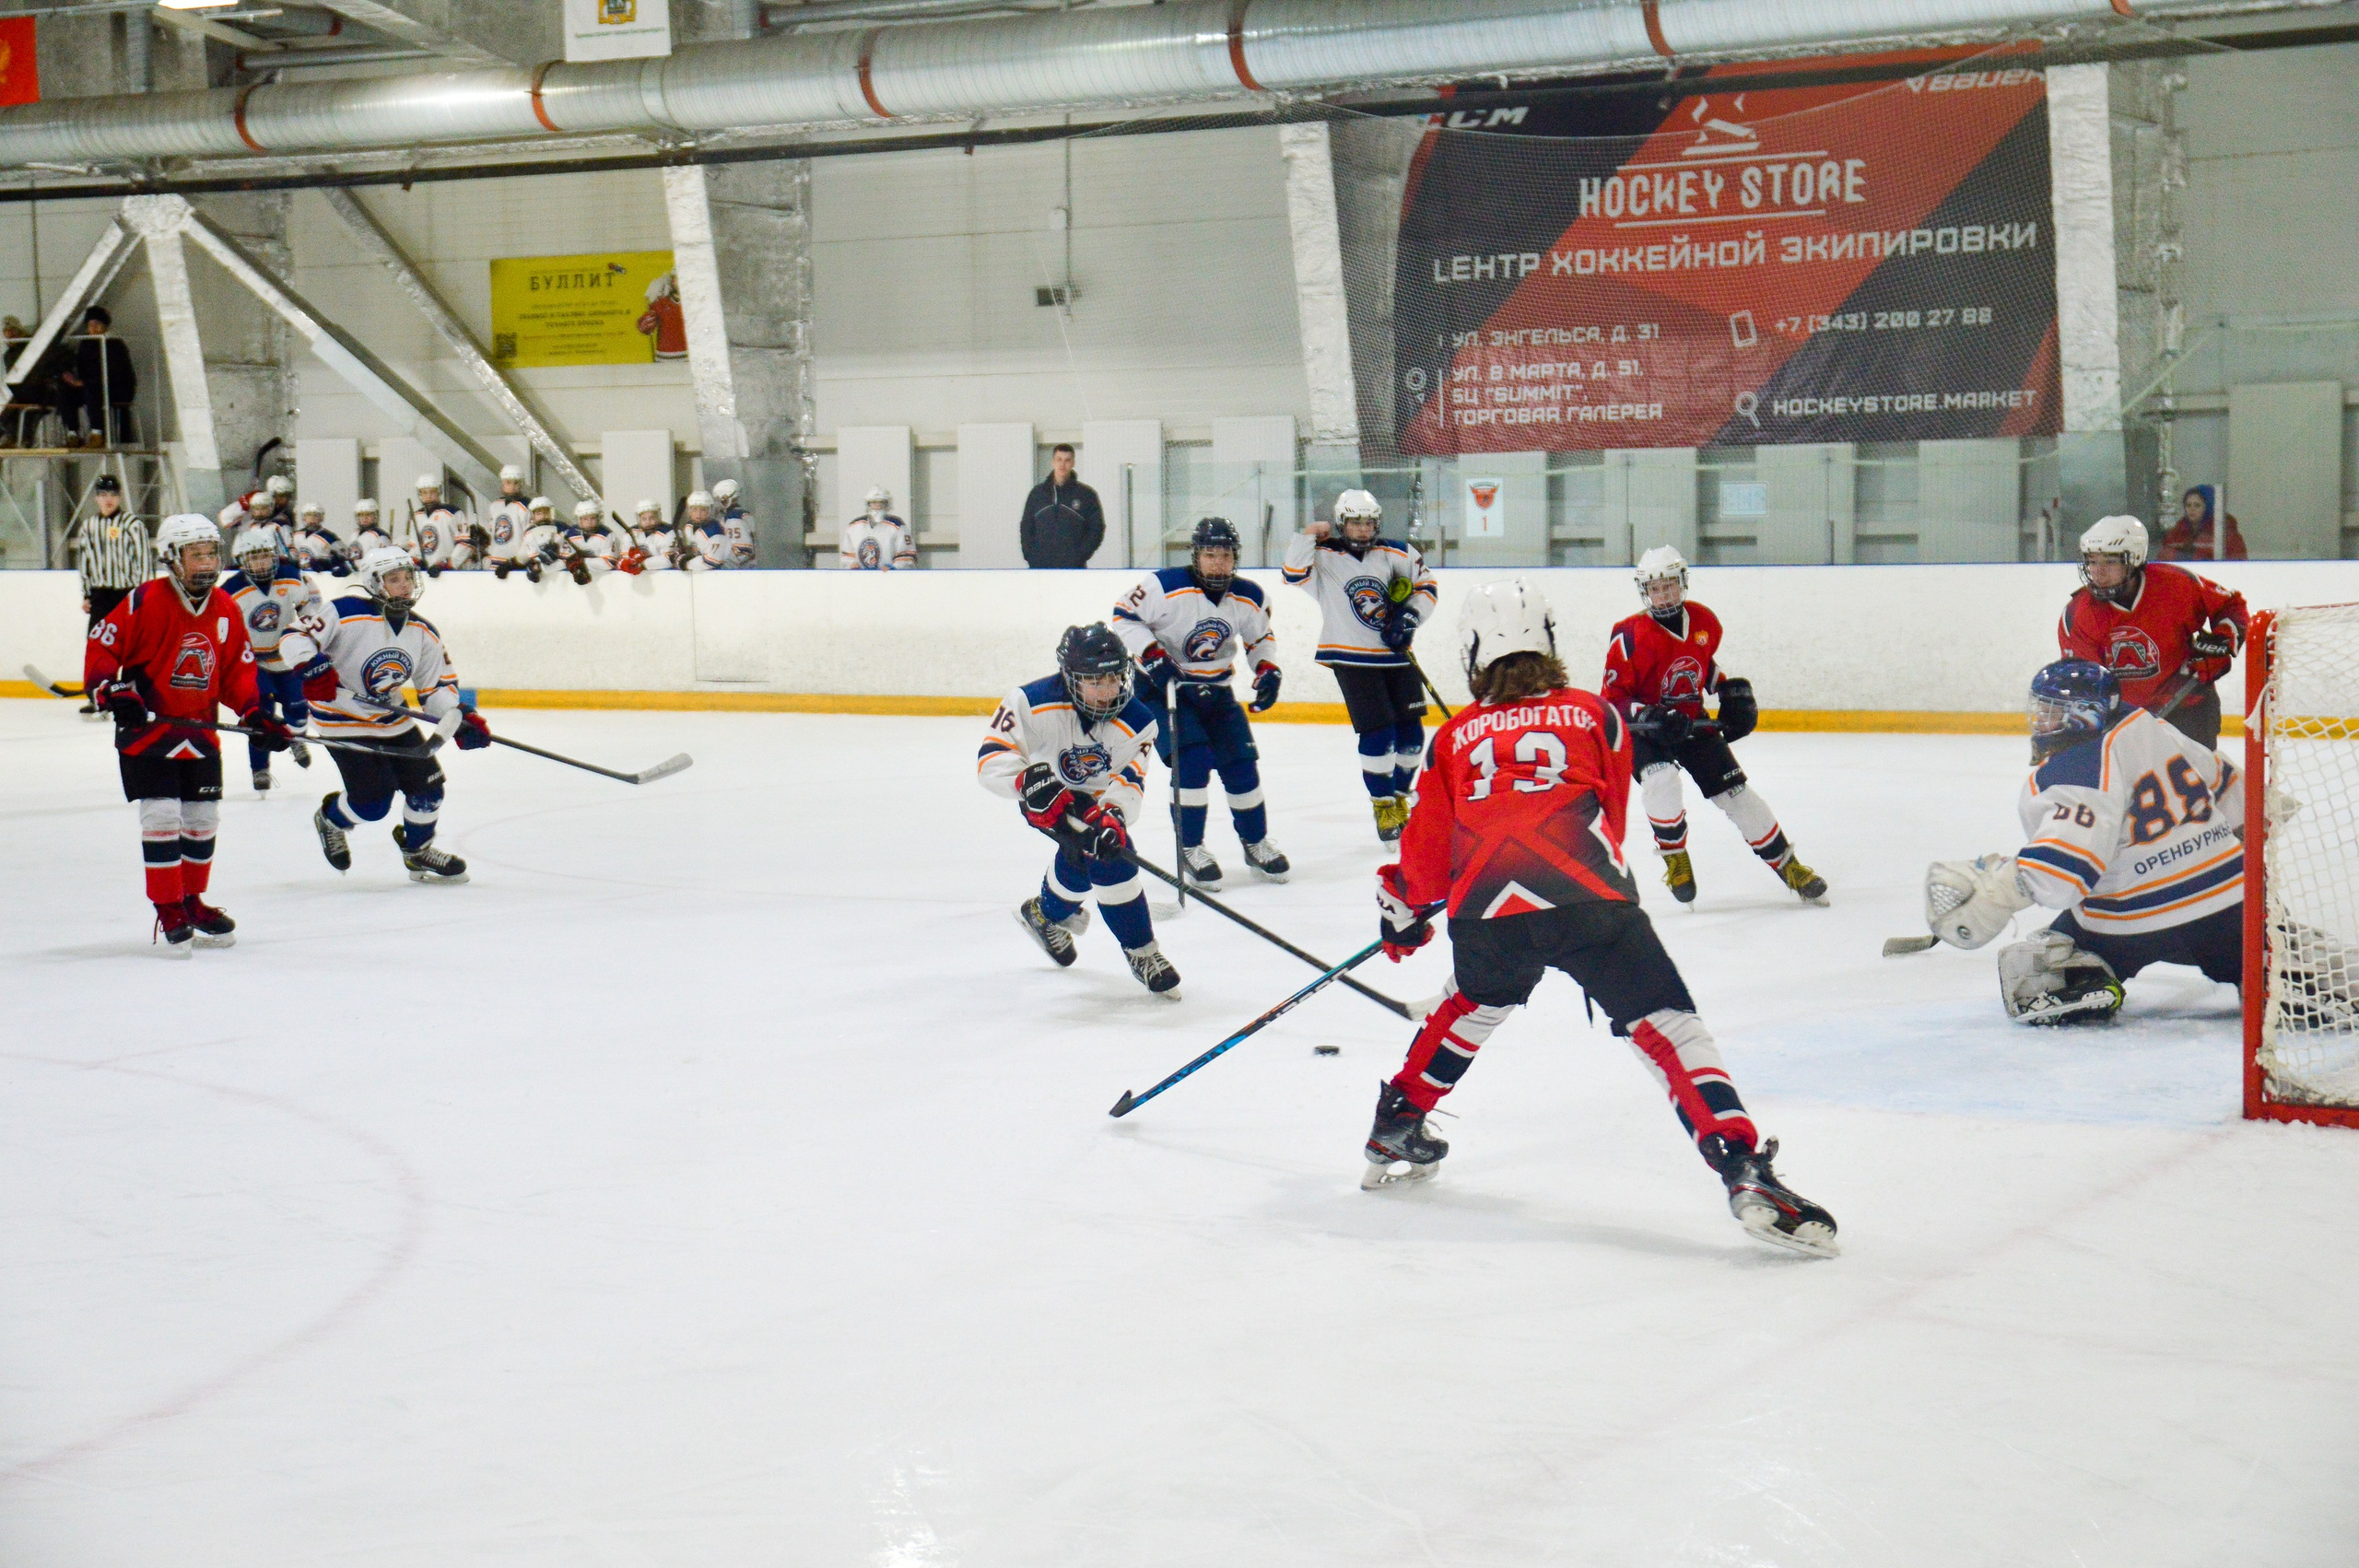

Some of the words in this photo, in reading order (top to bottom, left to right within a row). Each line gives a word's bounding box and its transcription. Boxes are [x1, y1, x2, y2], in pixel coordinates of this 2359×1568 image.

[1430, 106, 1530, 128] CM
[1579, 170, 1724, 218] HOCKEY
[1741, 158, 1867, 208] STORE
[1552, 230, 1766, 276] ХОККЕЙНОЙ
[1780, 221, 2037, 263] ЭКИПИРОВКИ
[530, 272, 616, 291] БУЛЛИТ
[1927, 309, 1954, 326] 27
[1637, 323, 1660, 340] 31
[1567, 403, 1663, 422] ГАЛЕРЕЯ
[1772, 389, 2037, 416] HOCKEYSTORE.MARKET
[1126, 583, 1147, 607] 2
[2196, 641, 2228, 654] UER
[1604, 669, 1618, 685] 2
[991, 705, 1015, 732] 16
[1468, 731, 1569, 801] 13
[1027, 774, 1057, 797] BAUE
[2125, 753, 2213, 846] 88
